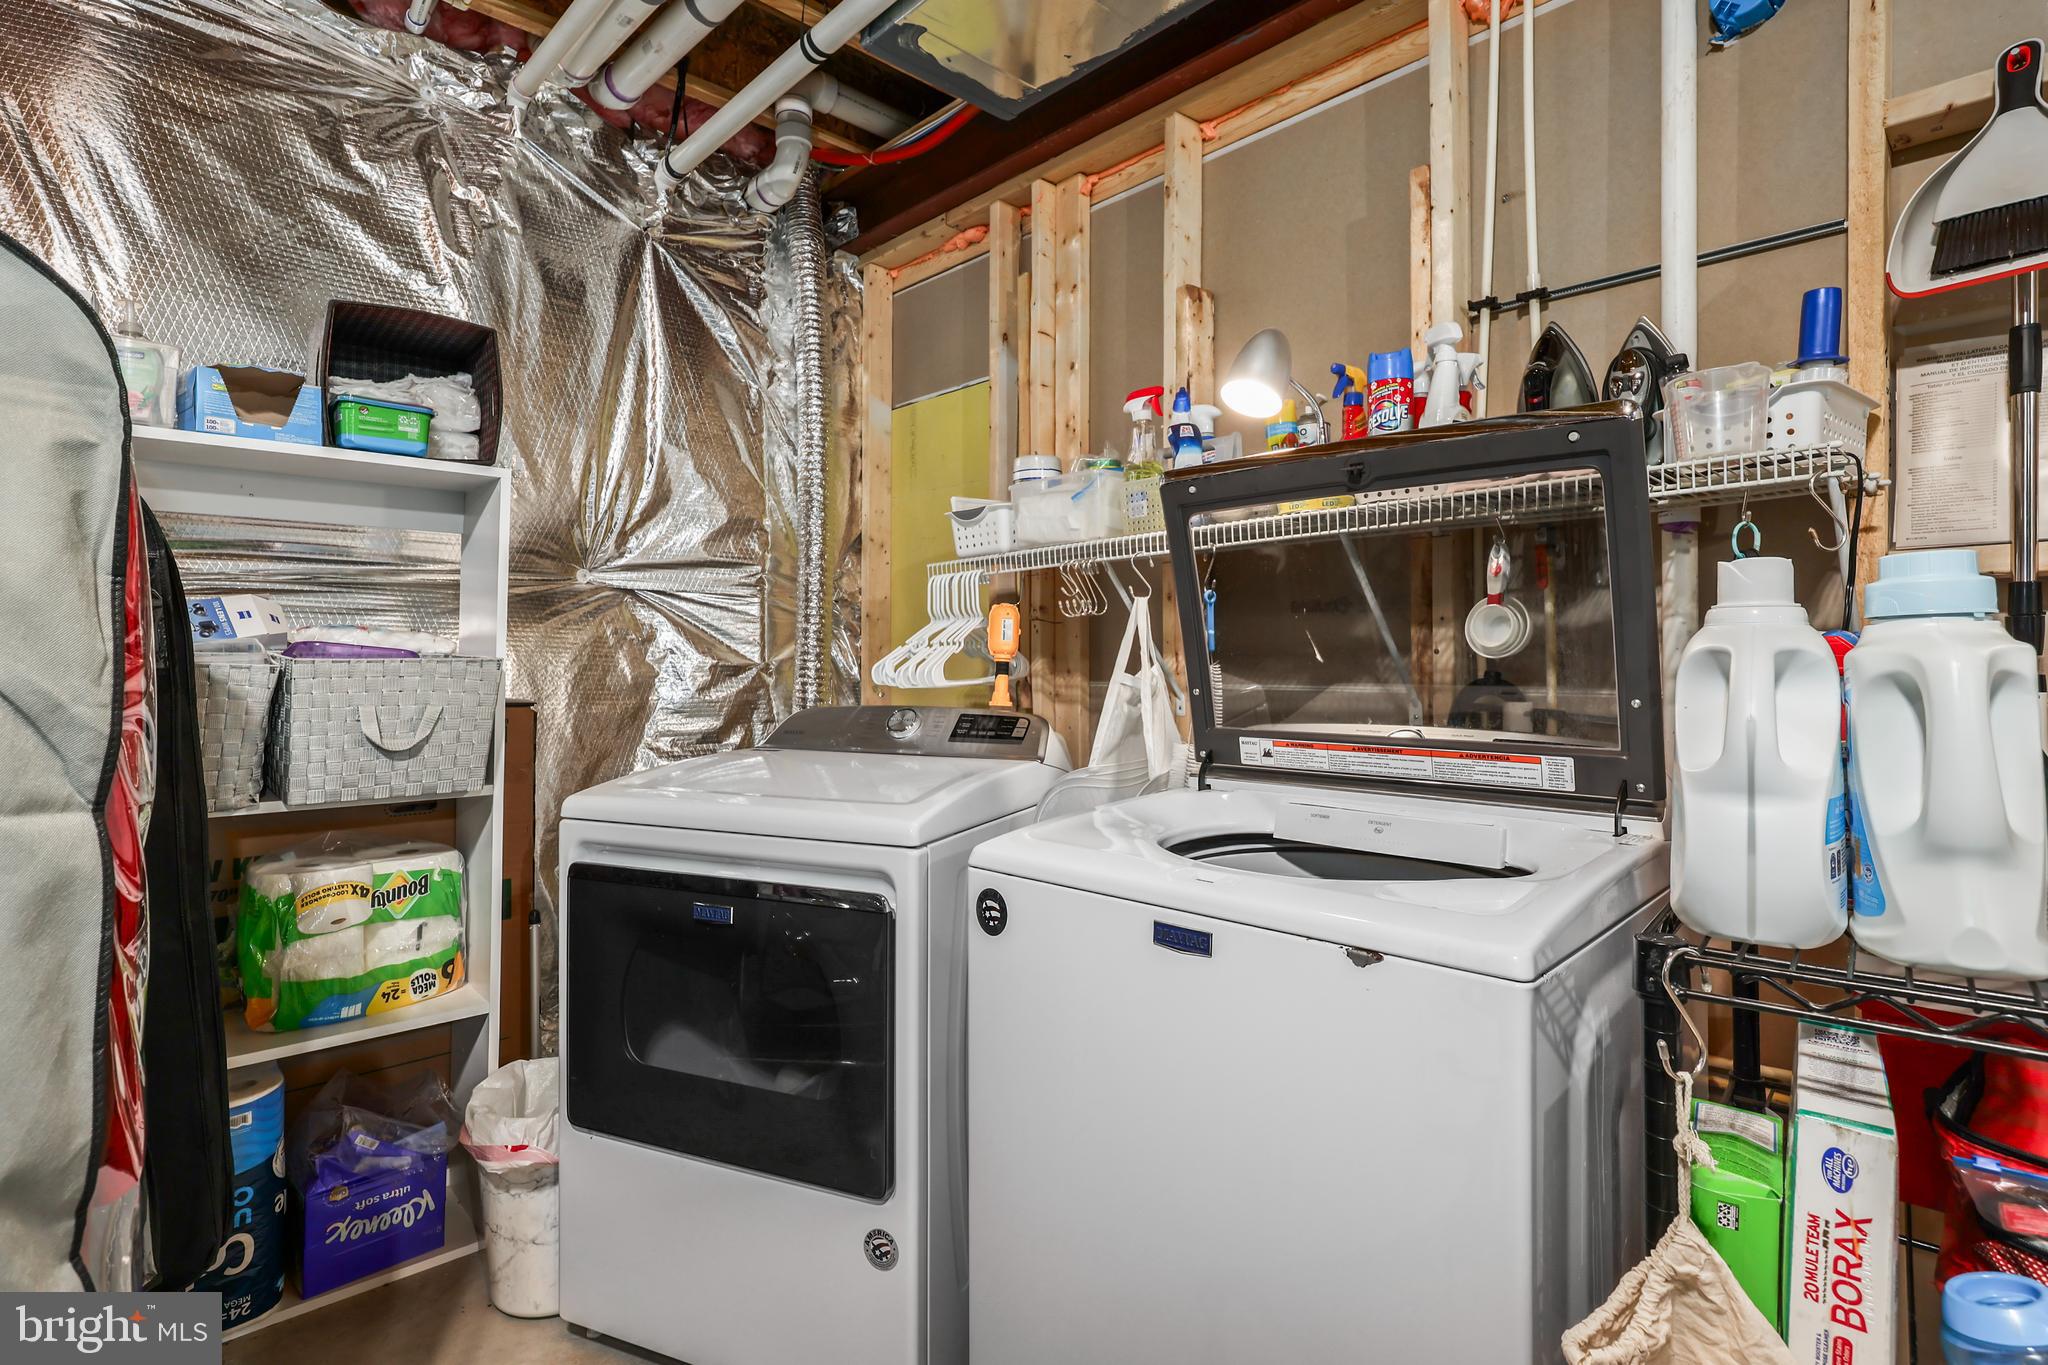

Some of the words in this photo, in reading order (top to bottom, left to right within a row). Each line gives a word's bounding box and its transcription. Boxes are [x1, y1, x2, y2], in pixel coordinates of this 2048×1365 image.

[1945, 346, 1991, 360] INSTALLATION
[1920, 369, 1948, 378] MANUAL
[1959, 360, 2009, 372] INSTRUCCION
[1967, 367, 1999, 376] CUIDADO
[215, 607, 228, 624] LENS
[1355, 746, 1404, 755] AVERTISSEMENT
[1464, 752, 1511, 762] ADVERTENCIA
[1367, 819, 1393, 827] DETERGENT
[300, 890, 322, 904] ROLLS
[350, 883, 372, 898] 4X
[370, 873, 430, 909] Bounty
[1156, 926, 1209, 950] MAYTAG
[409, 971, 437, 988] ROLLS
[441, 957, 455, 990] 6
[380, 987, 400, 1004] 24
[411, 980, 437, 996] MEGA
[1825, 1157, 1834, 1170] ALL
[1831, 1151, 1842, 1189] MACHINES
[382, 1185, 411, 1201] ultra
[354, 1194, 380, 1211] soft
[324, 1188, 436, 1245] Kleenex
[1805, 1211, 1822, 1246] TEAM
[864, 1229, 895, 1248] AMERICA
[1803, 1247, 1820, 1283] MULE
[1830, 1207, 1874, 1335] BORAX
[223, 1293, 251, 1310] MEGA
[1803, 1282, 1820, 1304] 20
[230, 1301, 251, 1321] 24
